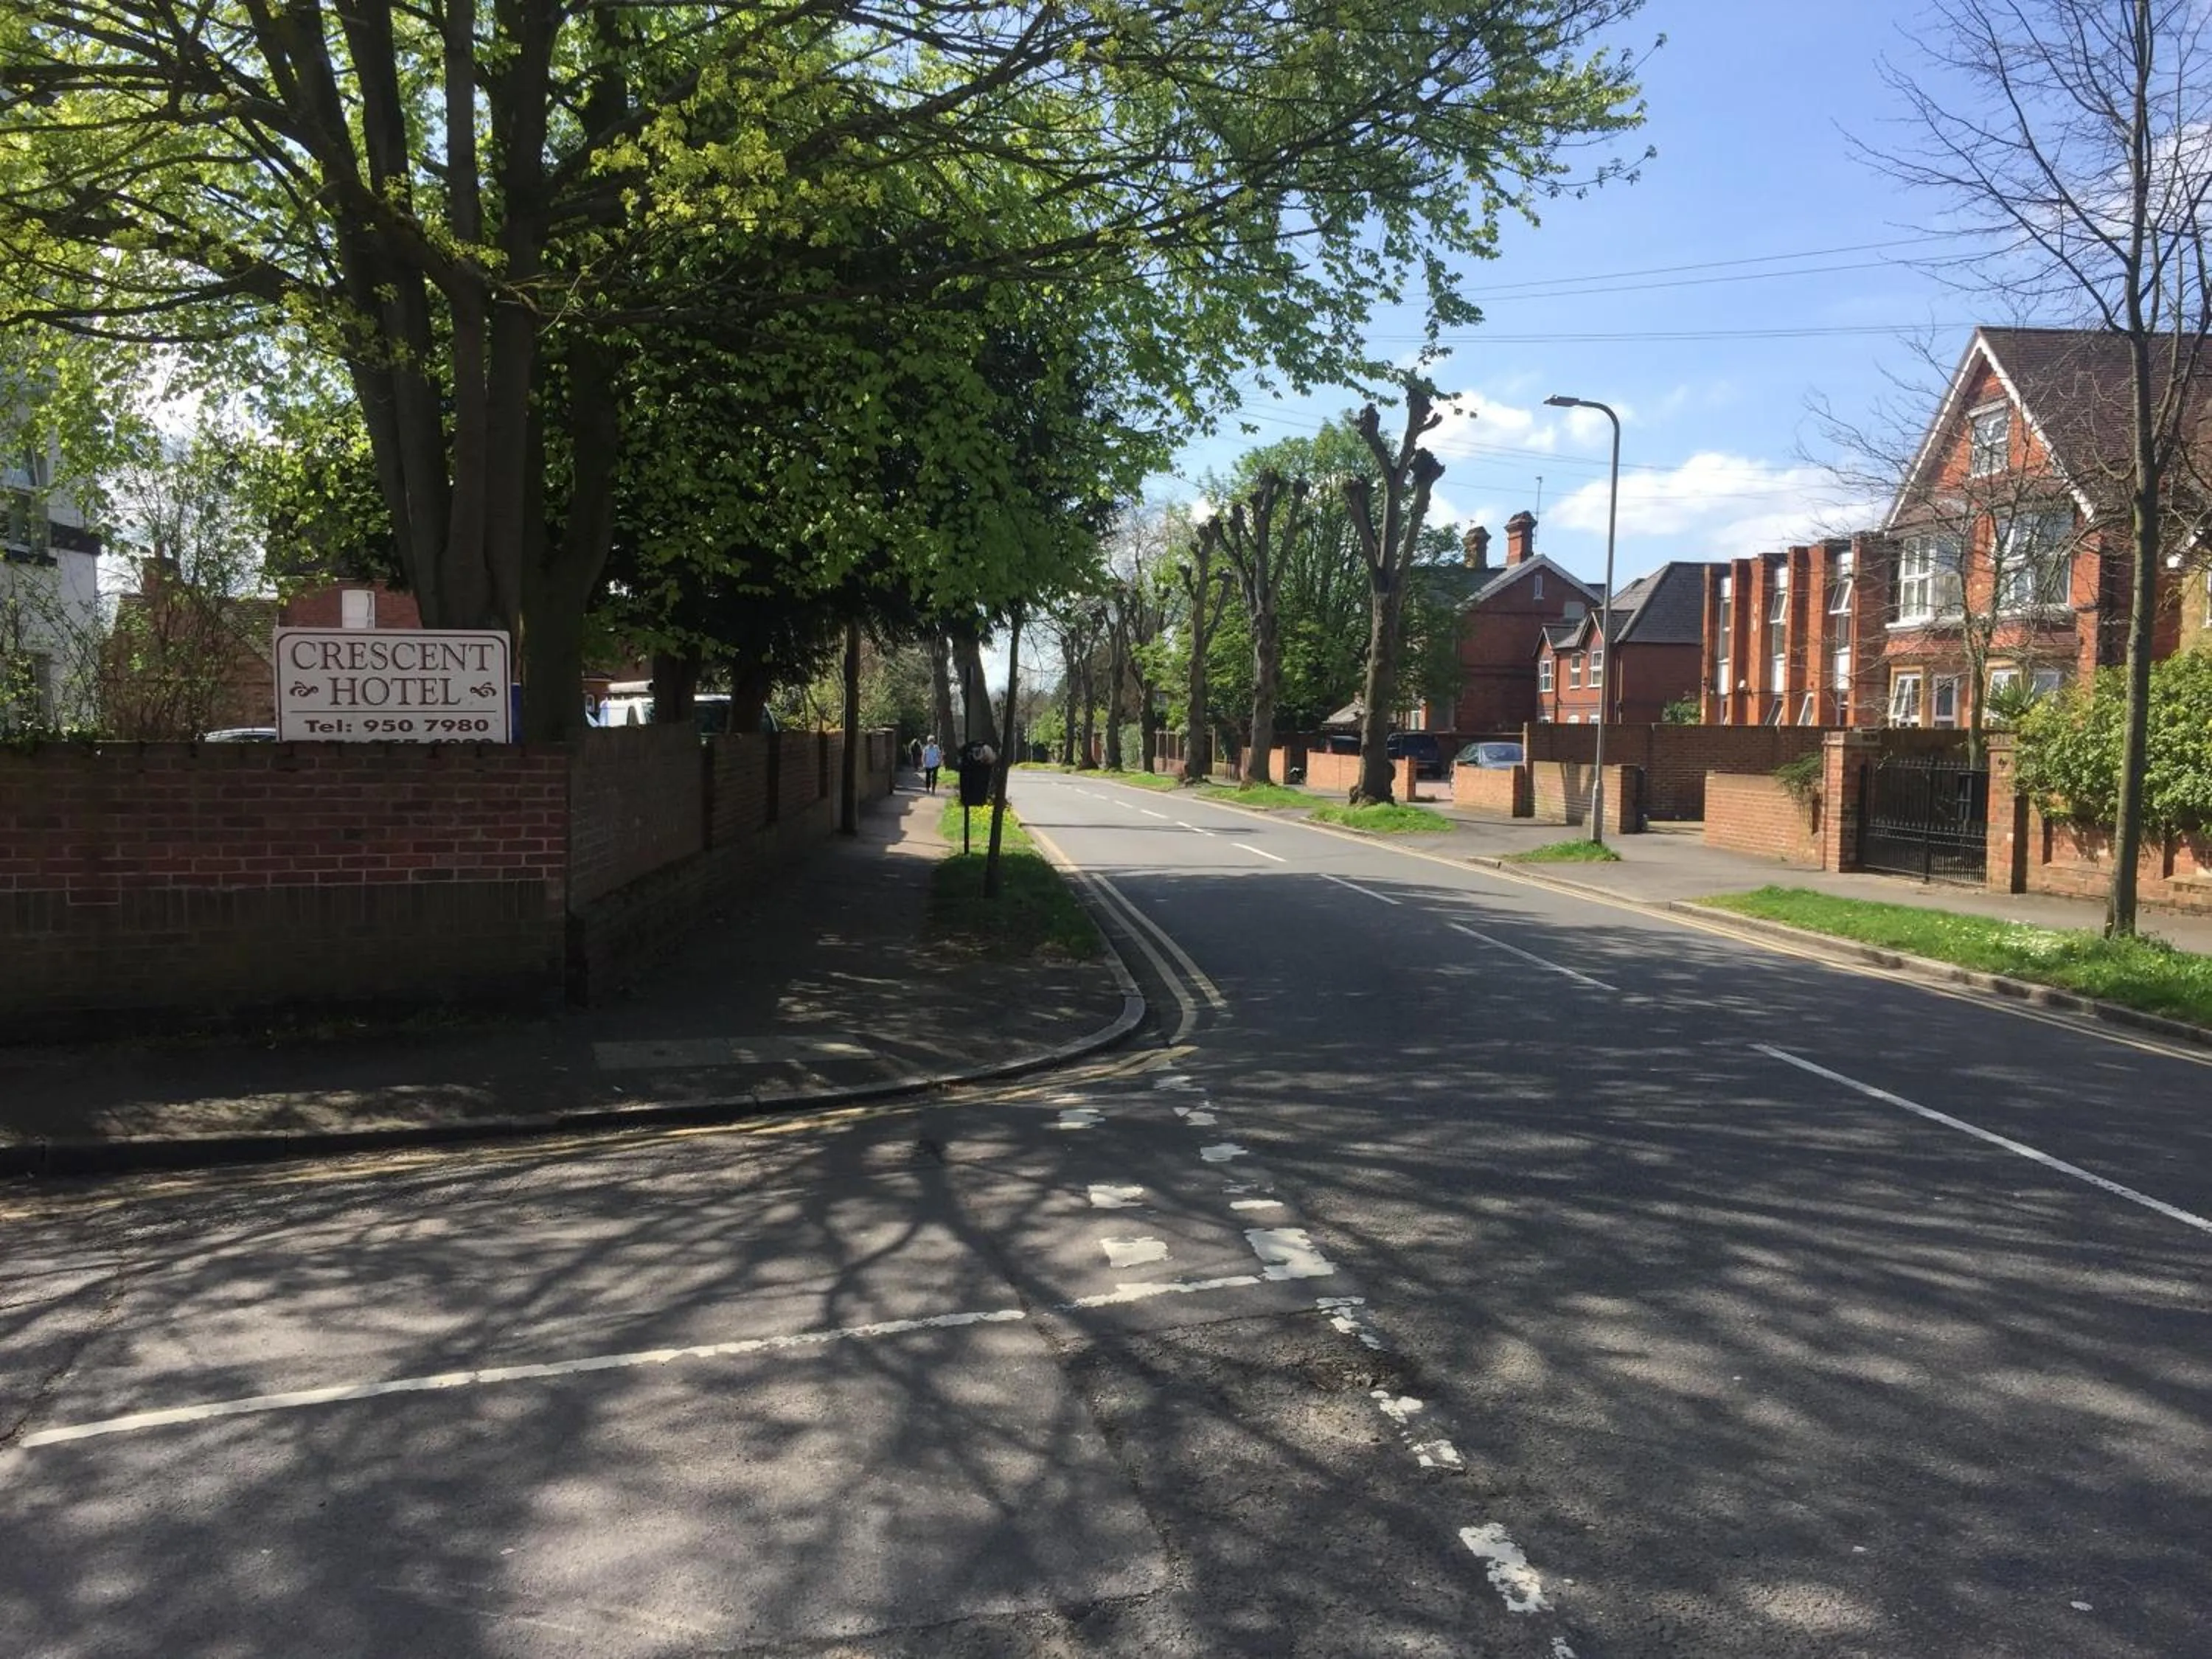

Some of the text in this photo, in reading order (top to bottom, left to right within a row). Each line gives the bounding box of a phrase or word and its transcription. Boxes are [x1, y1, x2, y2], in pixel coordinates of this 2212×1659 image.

[291, 641, 494, 672] CRESCENT
[327, 677, 461, 706] HOTEL
[305, 719, 490, 733] Tel: 950 7980
